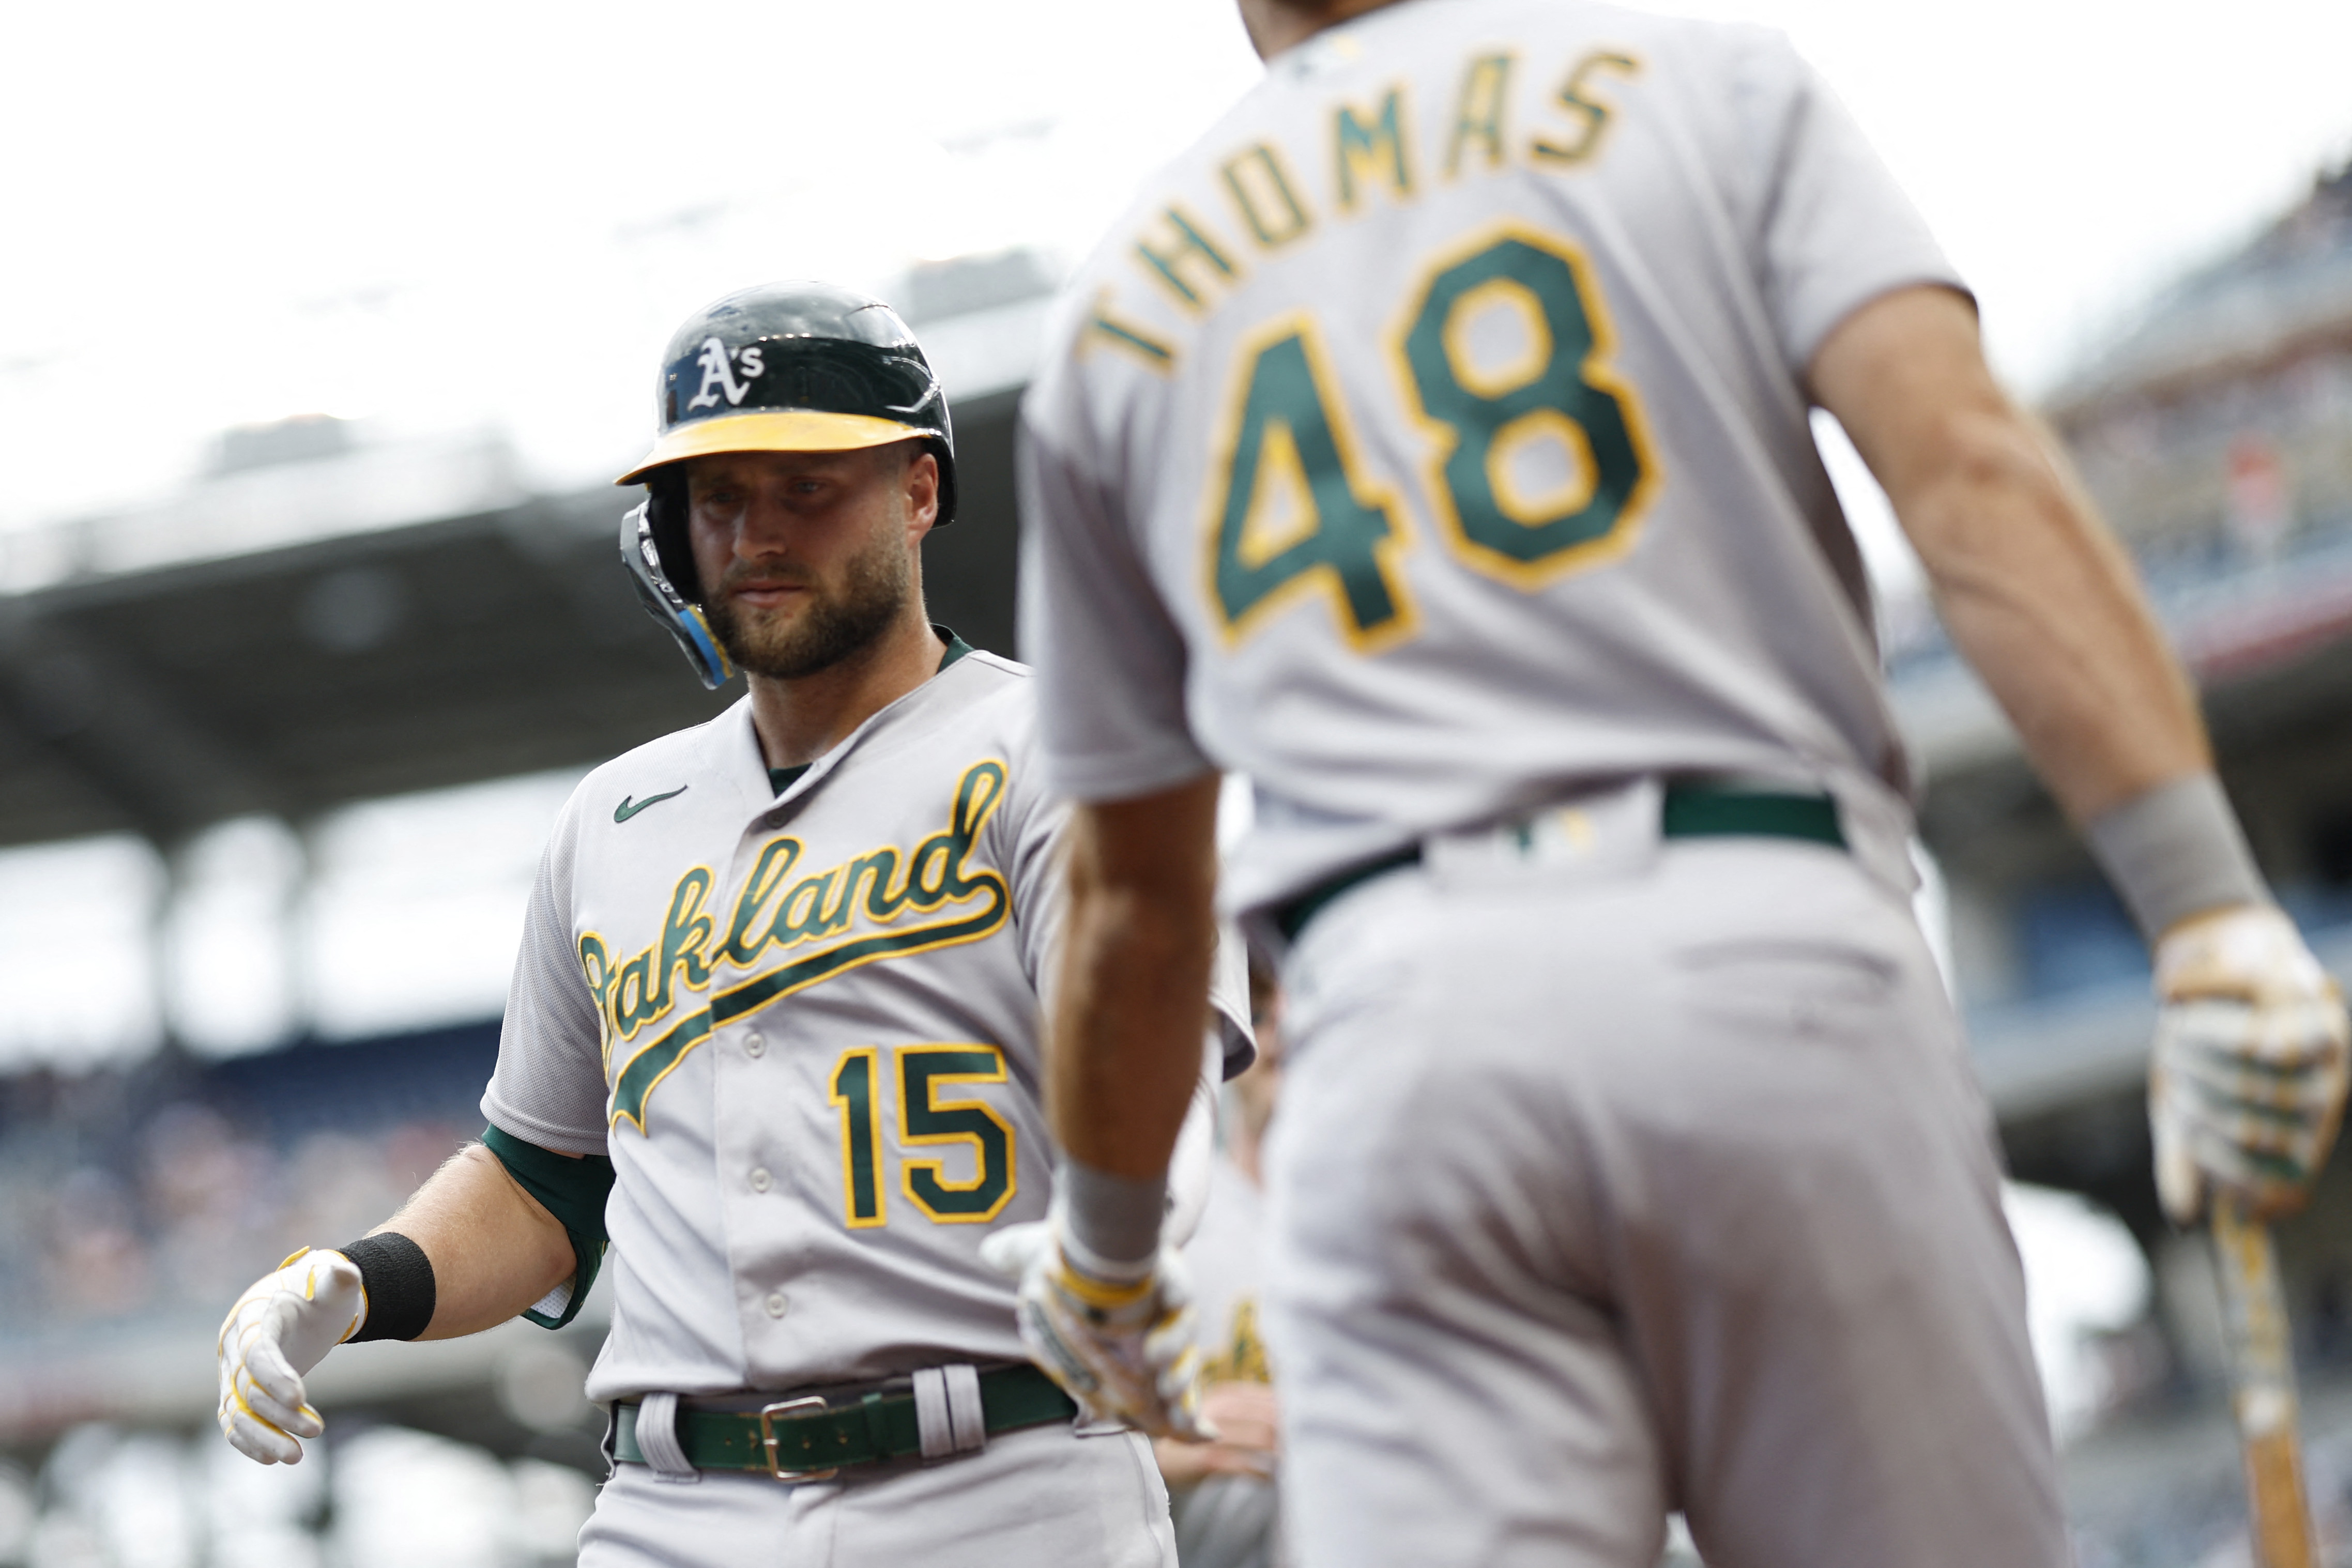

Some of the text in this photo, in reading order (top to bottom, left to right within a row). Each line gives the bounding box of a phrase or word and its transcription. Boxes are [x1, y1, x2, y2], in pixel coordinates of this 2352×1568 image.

[1076, 48, 1643, 378] THOMAS
[686, 337, 765, 412] A's
[1202, 217, 1662, 654] 48
[830, 1043, 1017, 1228] 15
